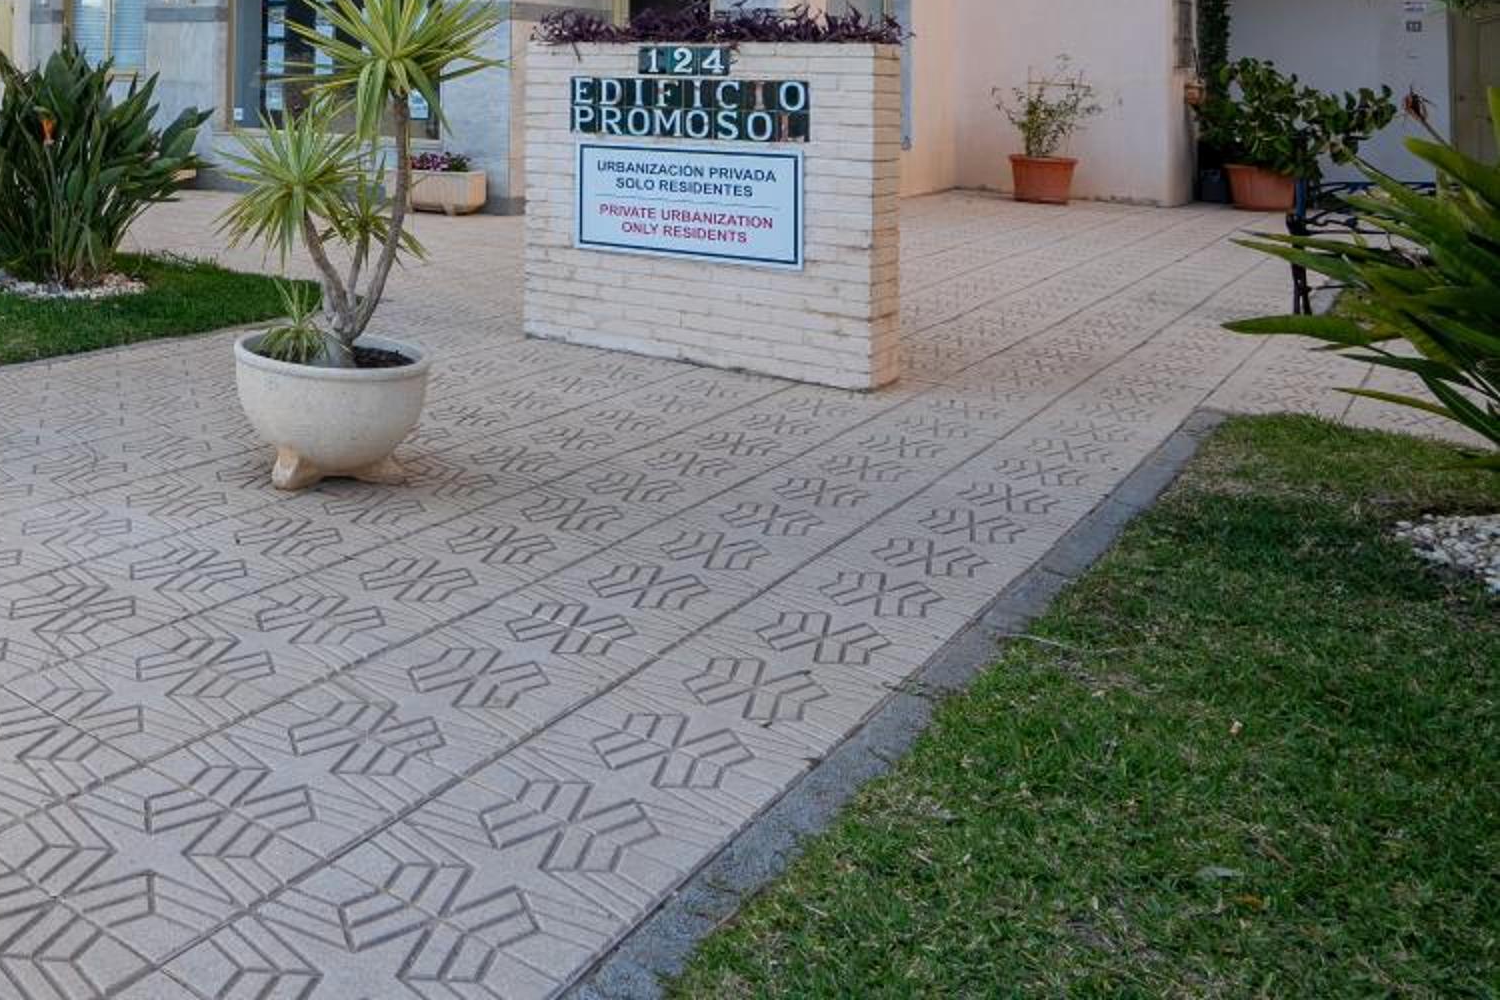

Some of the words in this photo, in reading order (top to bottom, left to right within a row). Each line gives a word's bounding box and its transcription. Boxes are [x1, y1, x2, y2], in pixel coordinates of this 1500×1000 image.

[647, 47, 725, 74] 124
[574, 77, 806, 111] EDIFICIO
[574, 106, 806, 142] PROMOSOL
[615, 177, 655, 191] SOLO
[659, 179, 754, 198] RESIDENTES
[709, 166, 777, 183] PRIVADA
[599, 203, 657, 219] PRIVATE
[661, 208, 774, 229] URBANIZATION
[621, 221, 658, 235] ONLY
[663, 225, 748, 244] RESIDENTS
